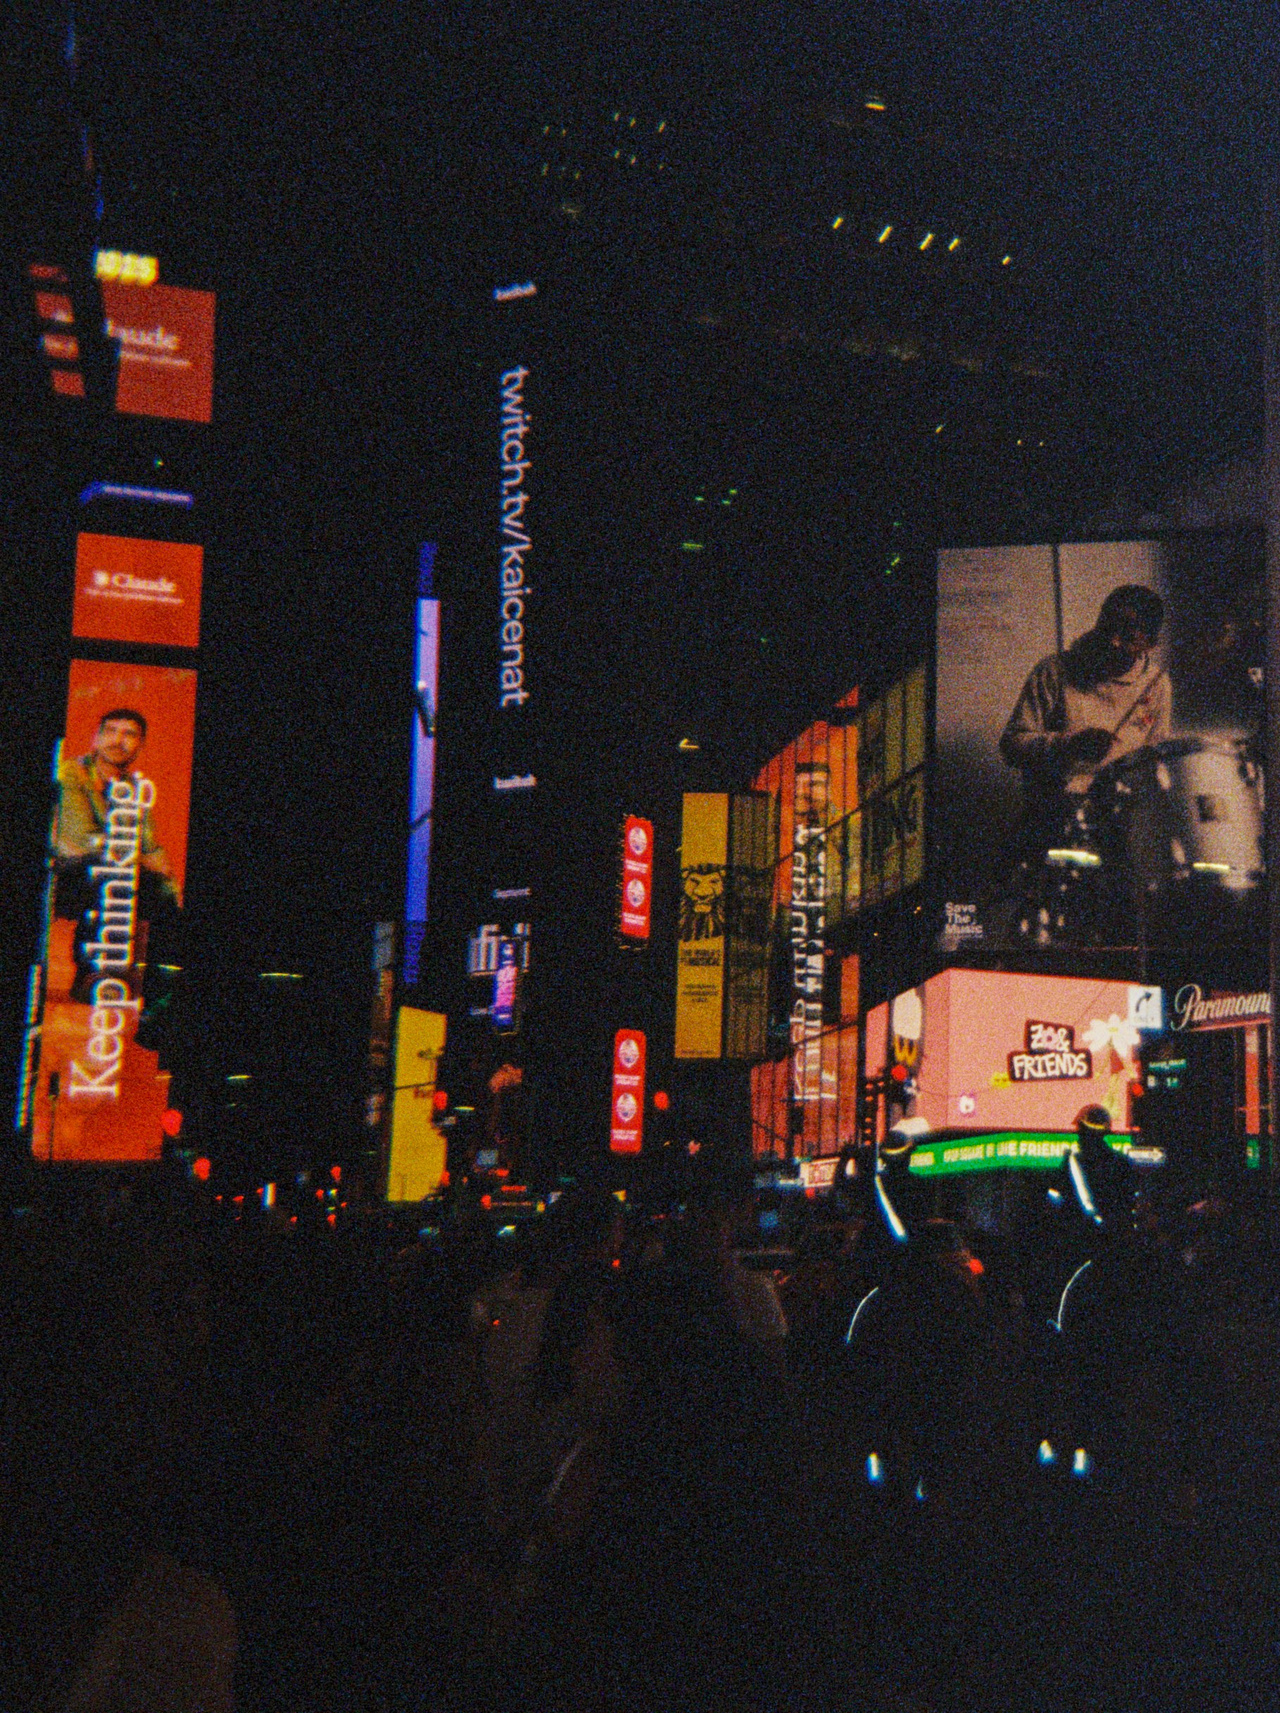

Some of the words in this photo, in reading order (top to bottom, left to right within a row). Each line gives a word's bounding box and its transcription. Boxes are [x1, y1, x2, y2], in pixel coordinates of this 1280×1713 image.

[501, 364, 532, 706] twitch.tv/kaicenat
[69, 977, 144, 1100] Keep
[1170, 983, 1272, 1031] Paramoun
[1012, 1052, 1088, 1080] FRIENDS
